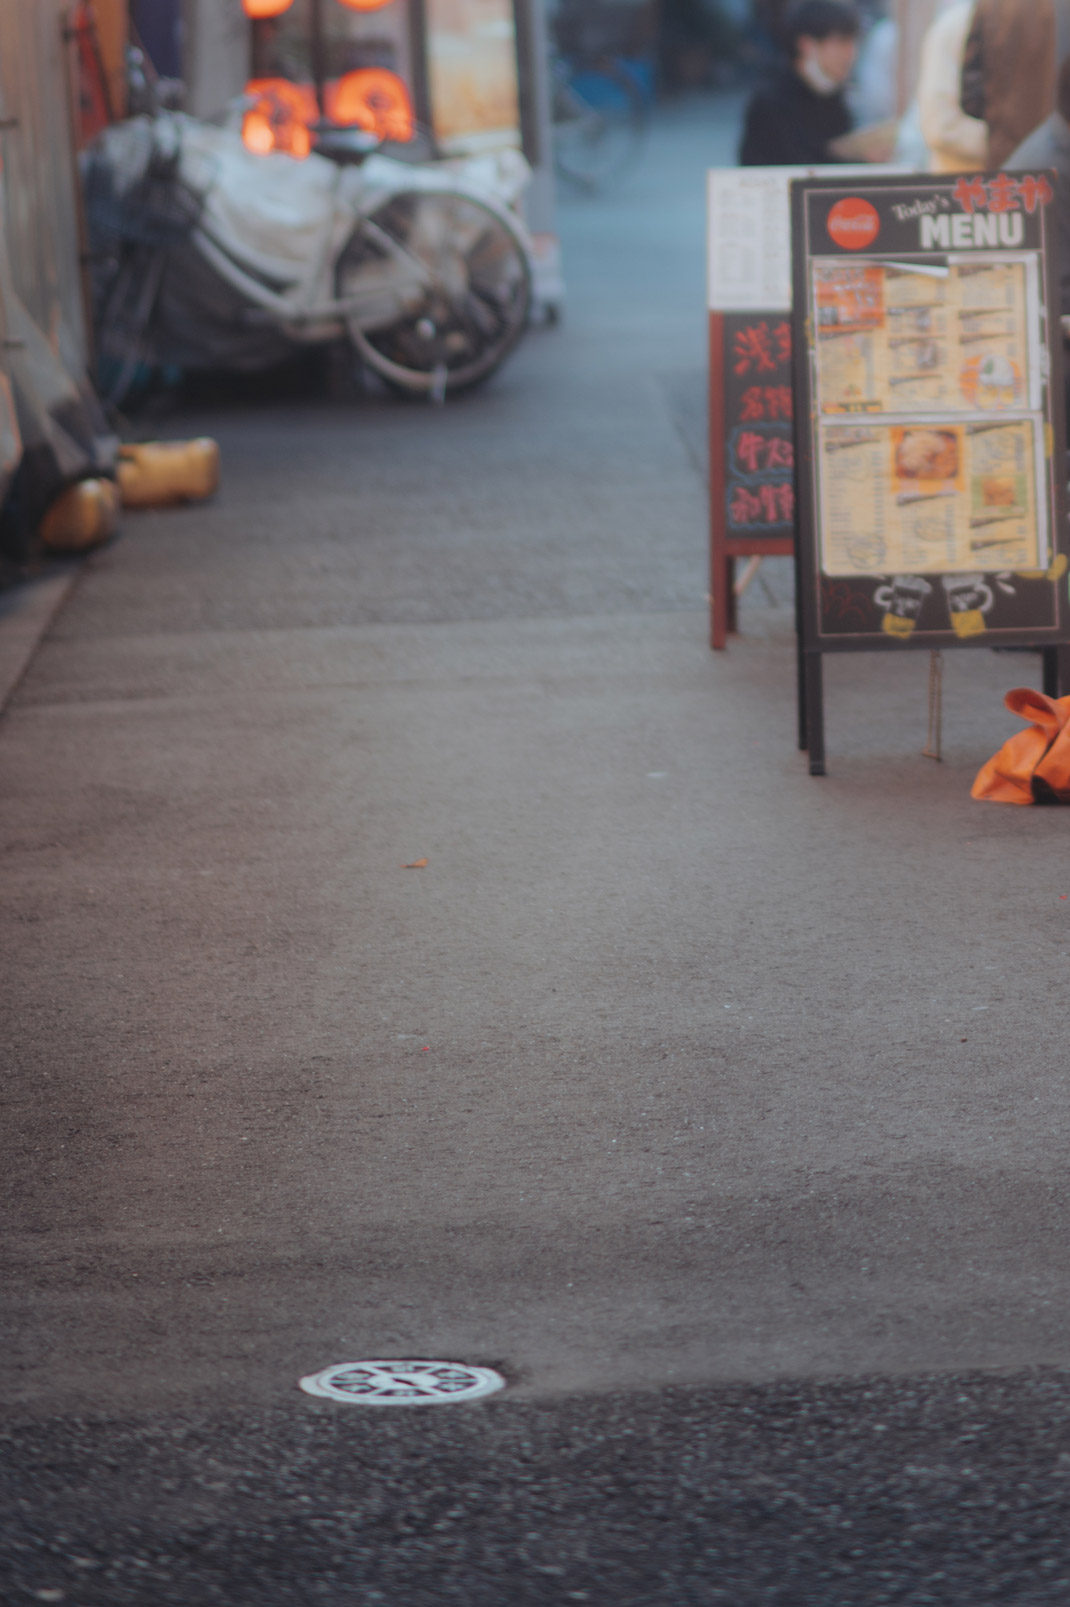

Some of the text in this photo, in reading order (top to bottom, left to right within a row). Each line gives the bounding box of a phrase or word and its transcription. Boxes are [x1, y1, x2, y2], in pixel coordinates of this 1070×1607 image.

[891, 194, 950, 221] Today's
[953, 173, 1054, 214] やまや
[919, 211, 1024, 250] MENU
